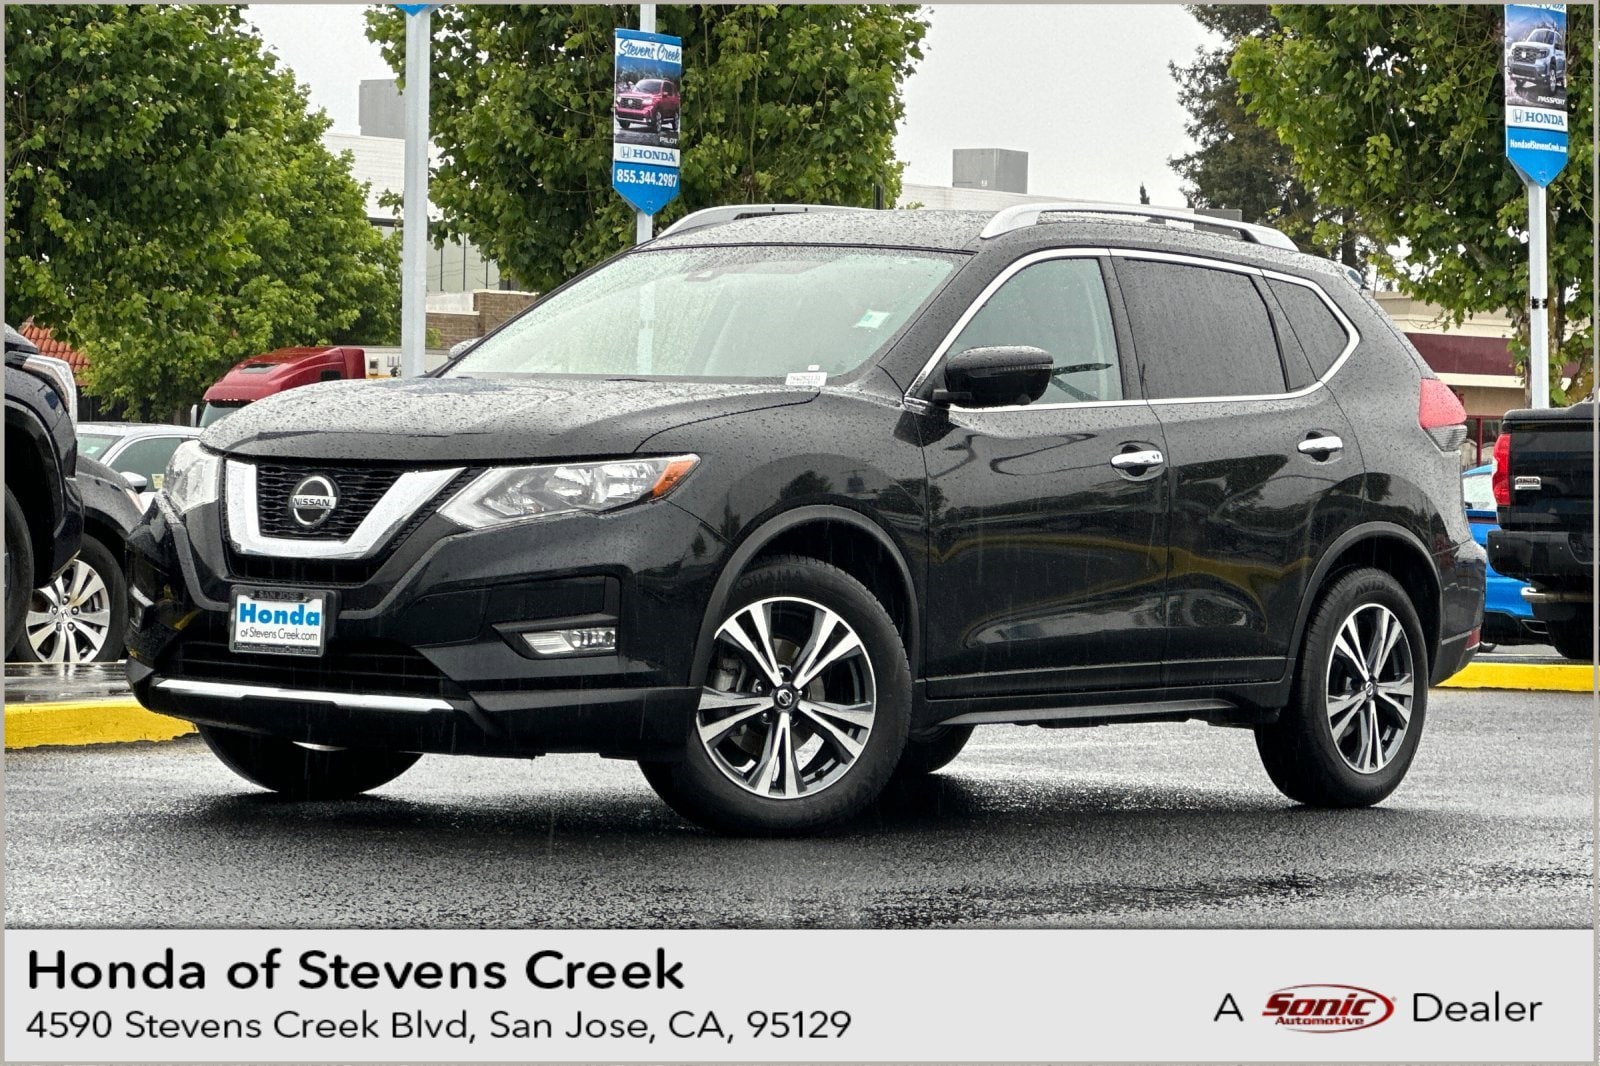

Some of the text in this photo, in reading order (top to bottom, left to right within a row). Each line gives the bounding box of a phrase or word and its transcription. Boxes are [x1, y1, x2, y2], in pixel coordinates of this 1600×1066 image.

[618, 39, 681, 62] Stevens Creek
[1537, 95, 1566, 105] PASSPORT
[1525, 111, 1565, 127] HONDA
[659, 136, 678, 145] PILOT
[632, 148, 676, 162] HONDA
[616, 168, 678, 188] 855.344.2987
[293, 497, 331, 506] NISSAN
[258, 590, 299, 600] SAN JOSE
[239, 602, 320, 626] Honda
[240, 626, 318, 641] of Stevens Creek.com
